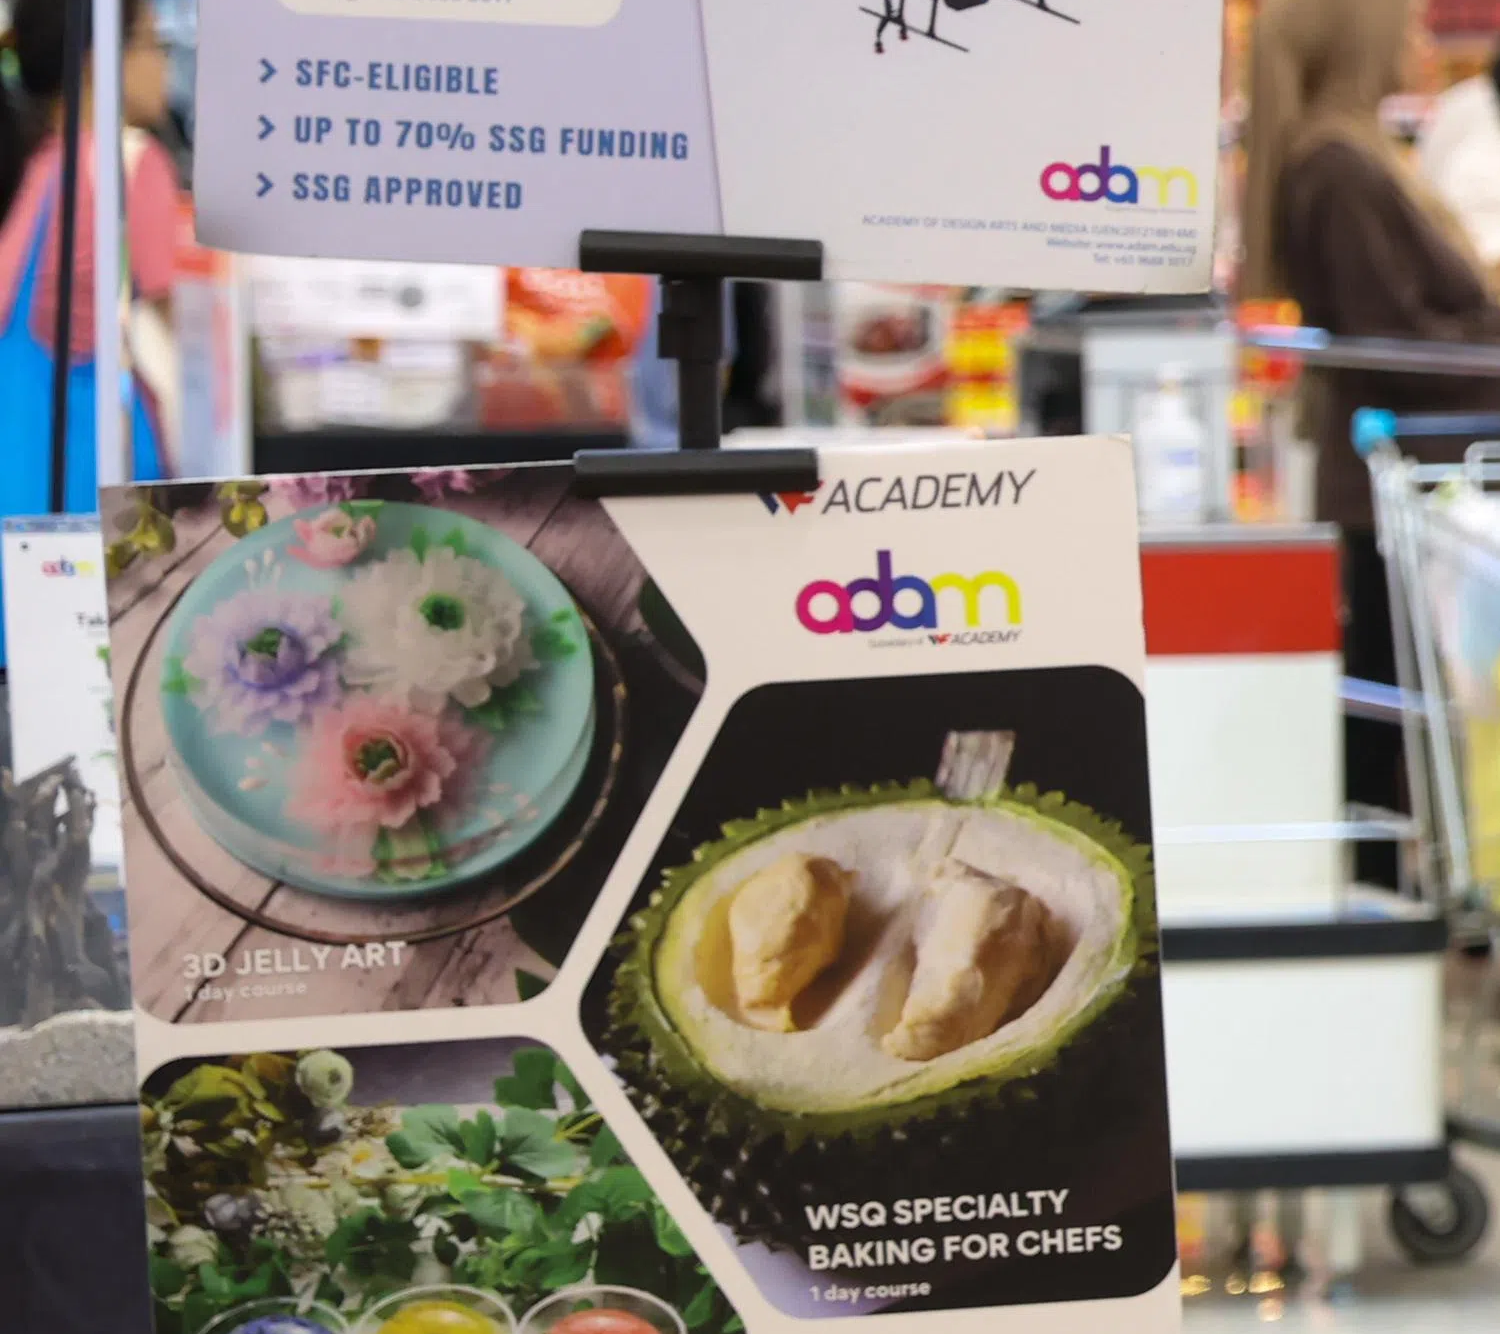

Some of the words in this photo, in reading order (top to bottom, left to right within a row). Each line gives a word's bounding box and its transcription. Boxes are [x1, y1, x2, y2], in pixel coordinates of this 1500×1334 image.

[296, 59, 499, 95] SFC-ELIGIBLE
[293, 116, 332, 144] UP
[345, 118, 382, 146] TO
[396, 121, 475, 151] 70%
[488, 124, 546, 154] SSG
[559, 128, 689, 161] FUNDING
[293, 174, 351, 202] SSG
[363, 176, 522, 210] APPROVED
[1040, 145, 1198, 207] adam
[862, 214, 920, 229] ACADEMY
[923, 216, 938, 229] OF
[942, 217, 986, 231] DESIGN
[990, 220, 1019, 232] ARTS
[1022, 221, 1048, 233] AND
[1050, 222, 1089, 235] MEDIA
[822, 469, 1037, 514] ACADEMY
[795, 549, 1022, 634] adam
[950, 629, 1022, 646] ACADEMY
[183, 952, 226, 979] 3D
[235, 945, 331, 977] JELLY
[341, 940, 408, 968] ART
[185, 986, 194, 1002] 1
[198, 985, 237, 1005] day
[241, 982, 307, 999] course
[805, 1202, 887, 1231] WSQ
[893, 1189, 1070, 1225] SPECIALTY
[808, 1237, 936, 1270] BAKING
[944, 1232, 1009, 1261] FOR
[1016, 1225, 1124, 1256] CHEFS
[810, 1285, 820, 1302] 1
[824, 1283, 860, 1304] day
[865, 1281, 932, 1300] course
